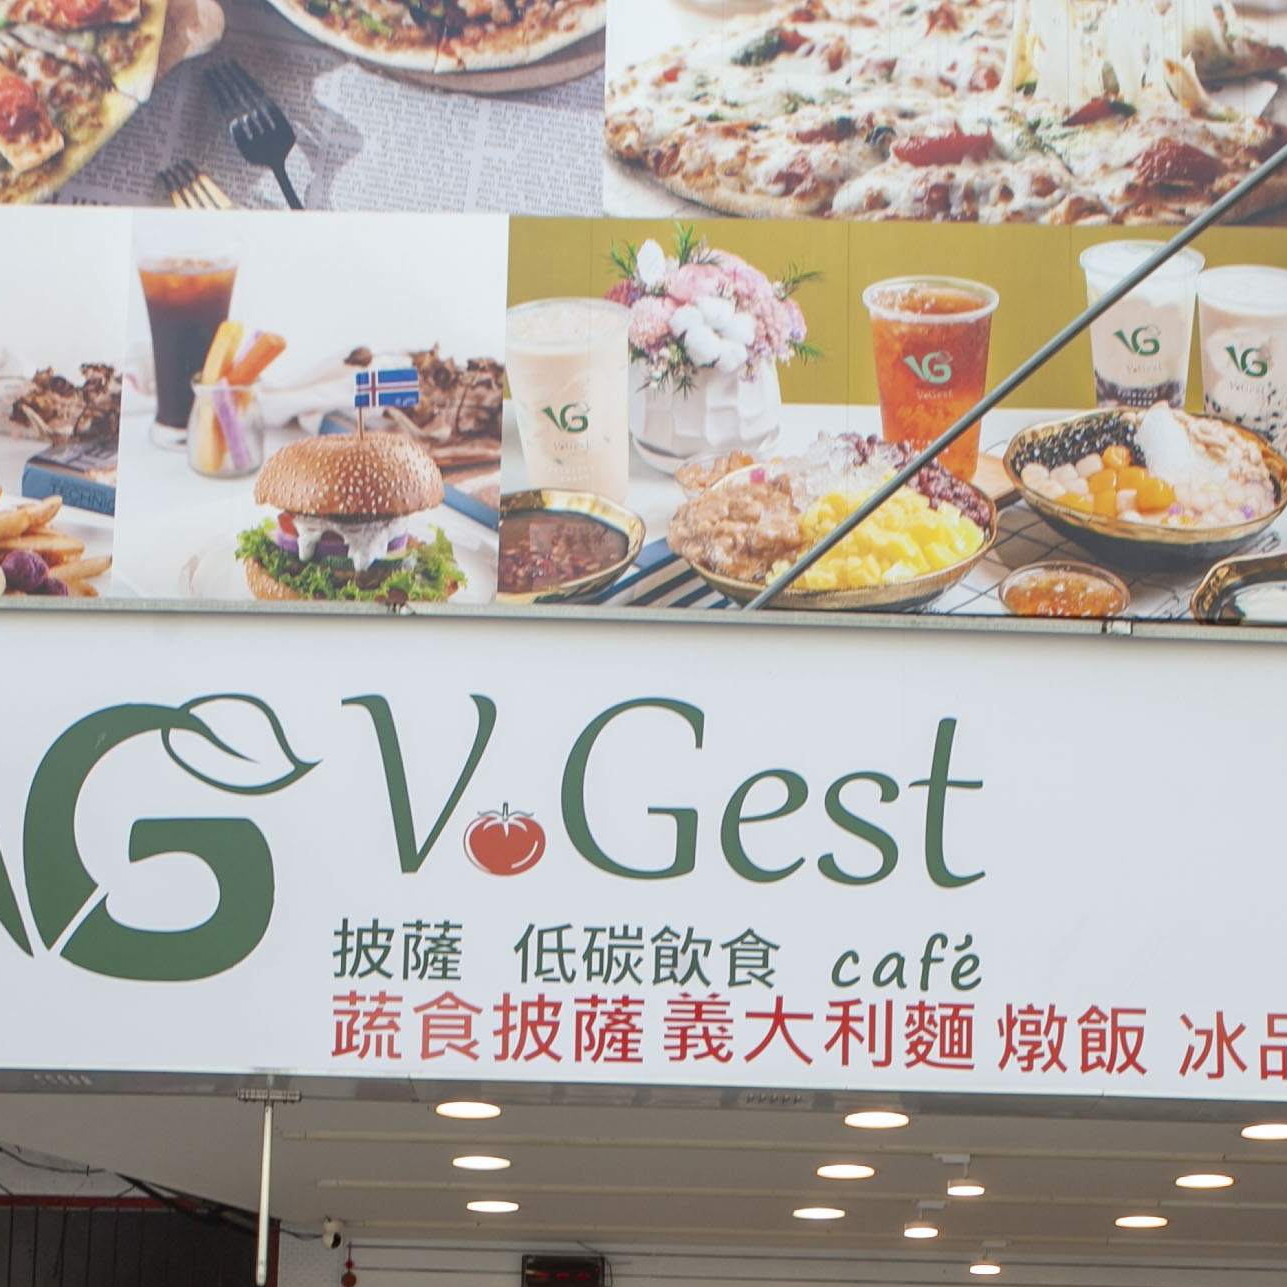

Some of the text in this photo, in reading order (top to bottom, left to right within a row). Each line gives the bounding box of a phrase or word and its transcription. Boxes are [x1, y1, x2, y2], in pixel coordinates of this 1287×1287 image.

[332, 917, 984, 992] 披薩 低碳飲食 café
